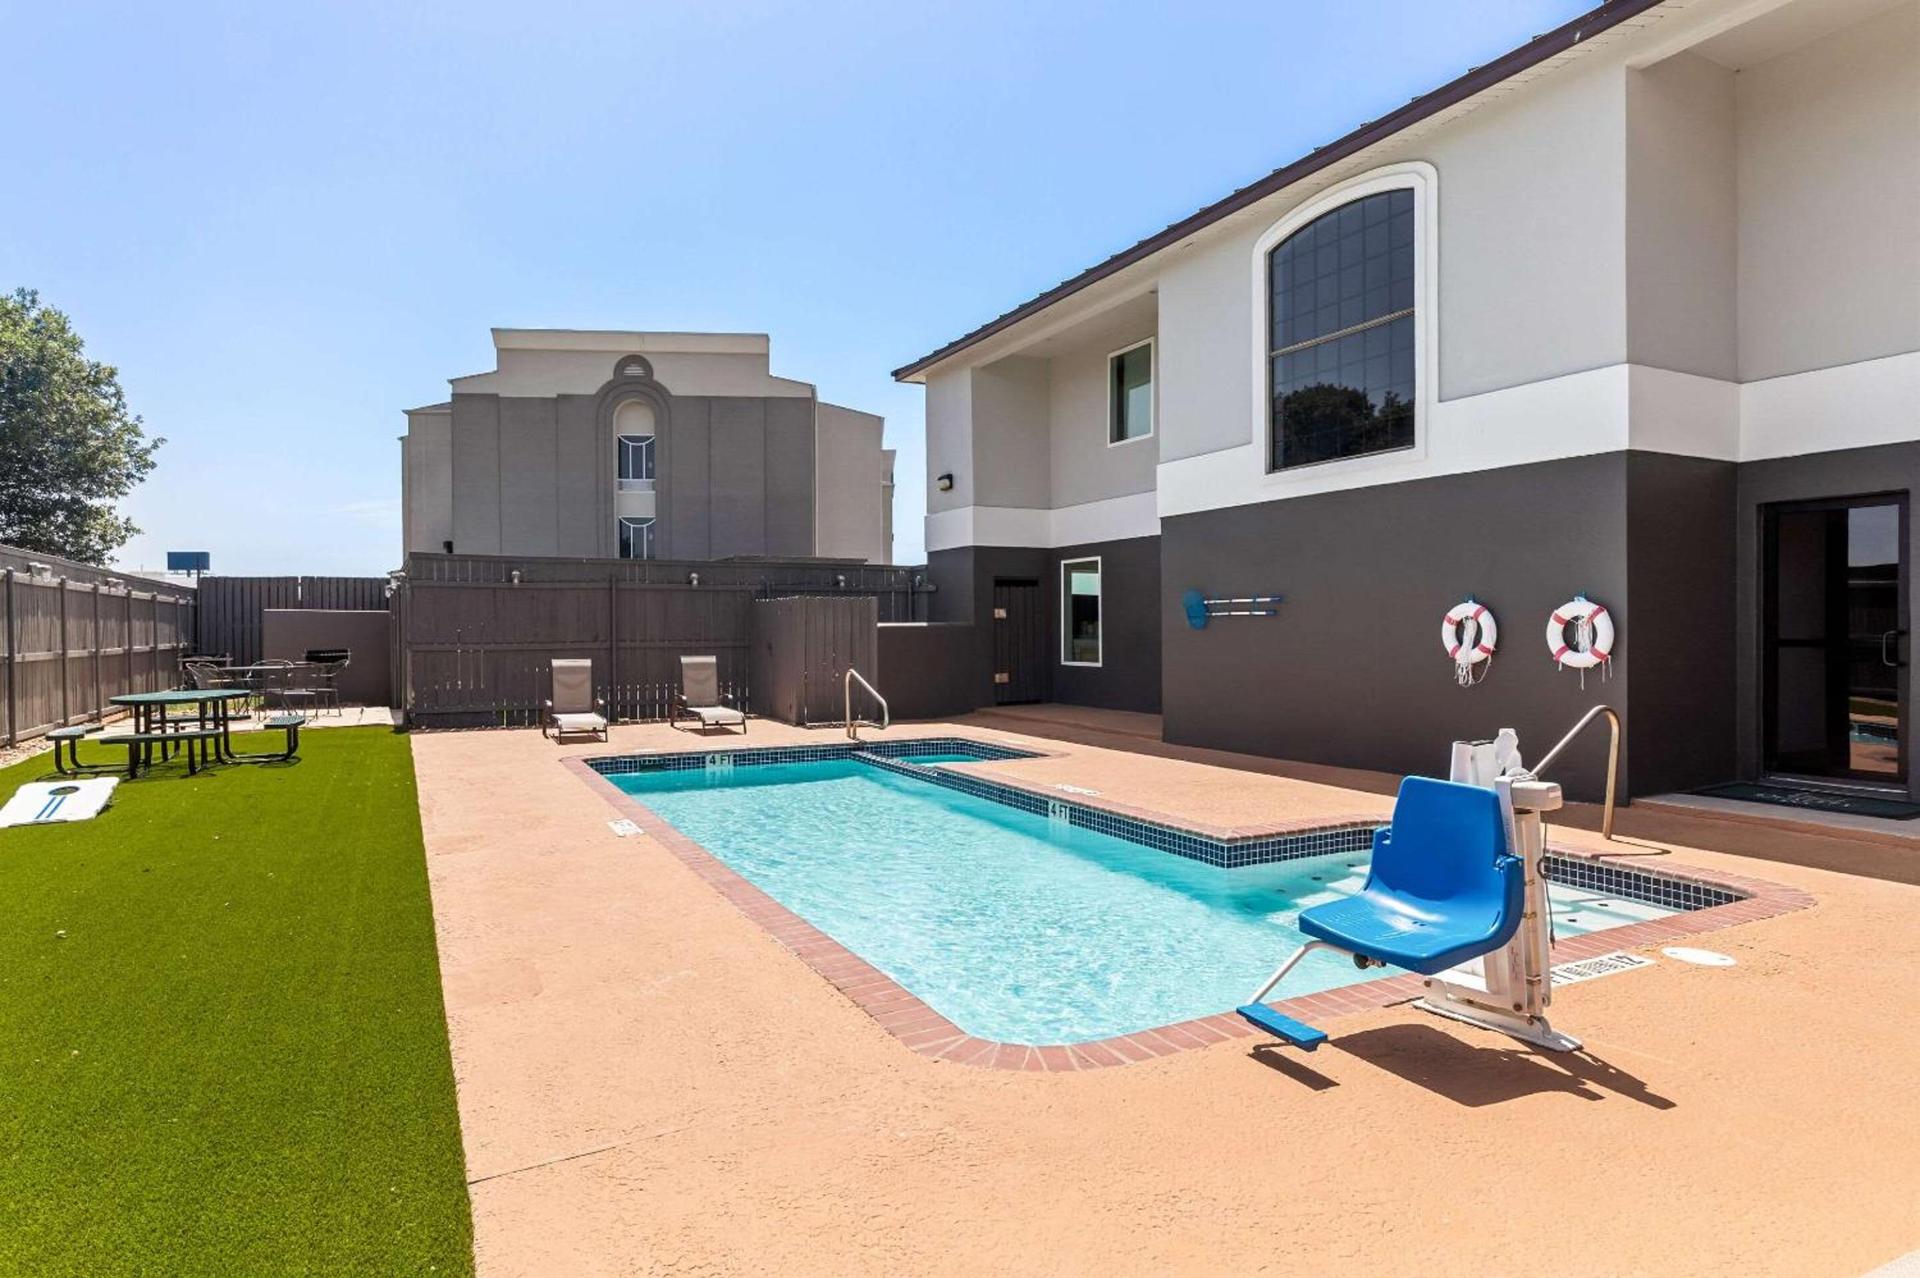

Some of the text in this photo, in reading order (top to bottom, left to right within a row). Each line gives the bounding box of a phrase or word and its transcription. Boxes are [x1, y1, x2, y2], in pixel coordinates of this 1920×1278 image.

[709, 754, 731, 765] 4 FT
[1059, 804, 1068, 820] FT
